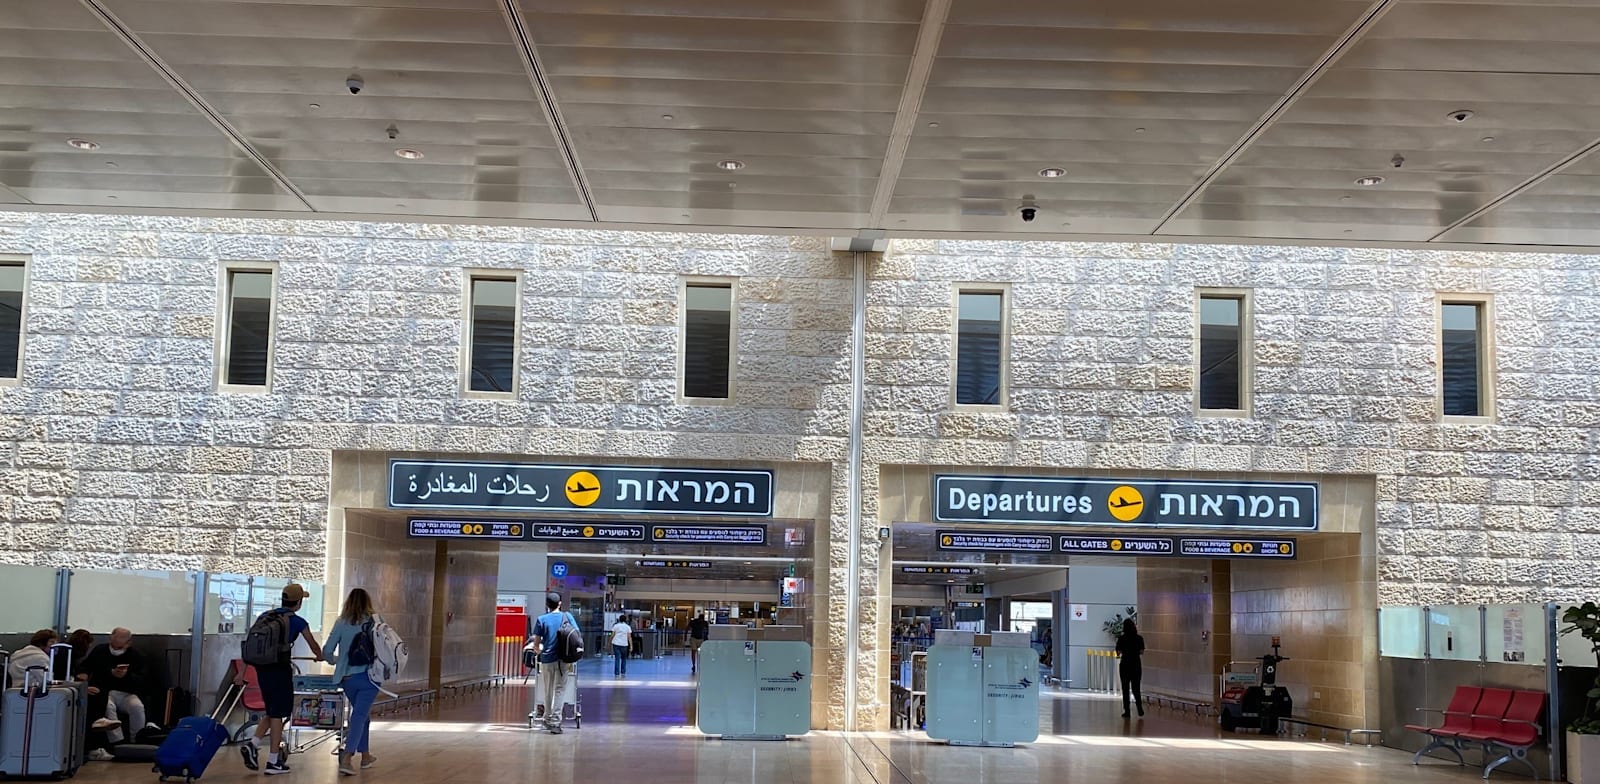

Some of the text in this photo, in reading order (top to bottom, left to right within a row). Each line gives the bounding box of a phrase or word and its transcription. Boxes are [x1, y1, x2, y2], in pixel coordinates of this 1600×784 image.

[408, 471, 550, 503] رحلات المغادرة
[616, 478, 755, 504] המראות
[949, 487, 1093, 517] Departures
[1159, 493, 1300, 518] המראות
[562, 528, 579, 536] جميع
[1159, 541, 1169, 550] כל
